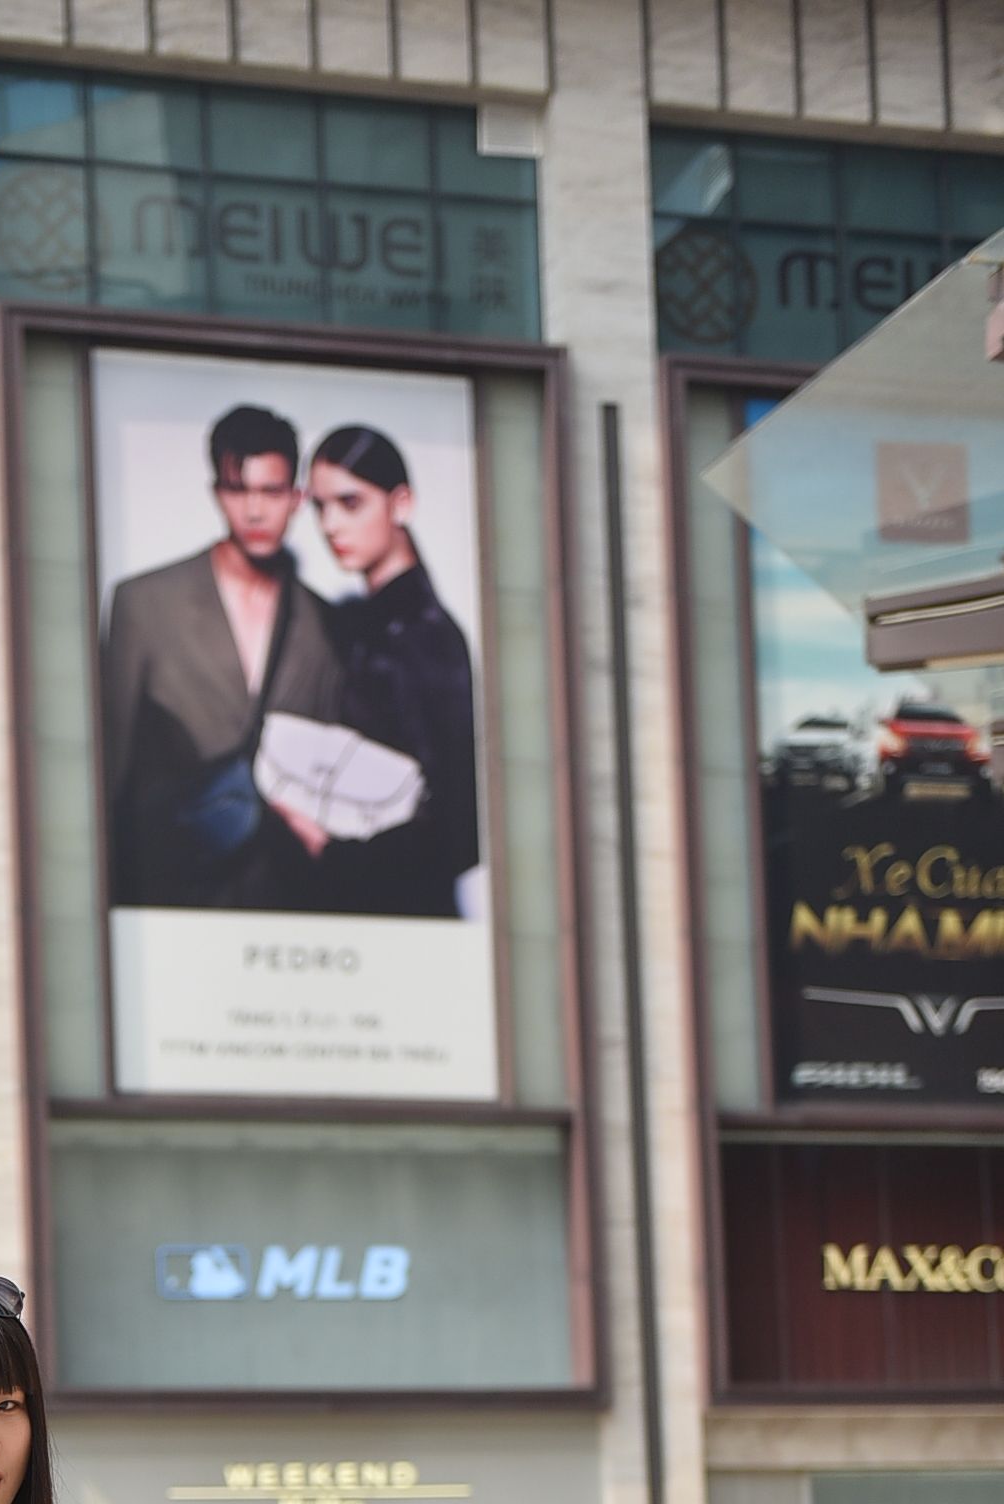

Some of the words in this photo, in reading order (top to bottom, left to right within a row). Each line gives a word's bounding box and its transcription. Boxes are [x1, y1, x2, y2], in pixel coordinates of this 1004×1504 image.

[241, 944, 362, 975] PEDRO
[256, 1244, 411, 1300] MLB
[223, 1460, 419, 1490] WEEKEND
